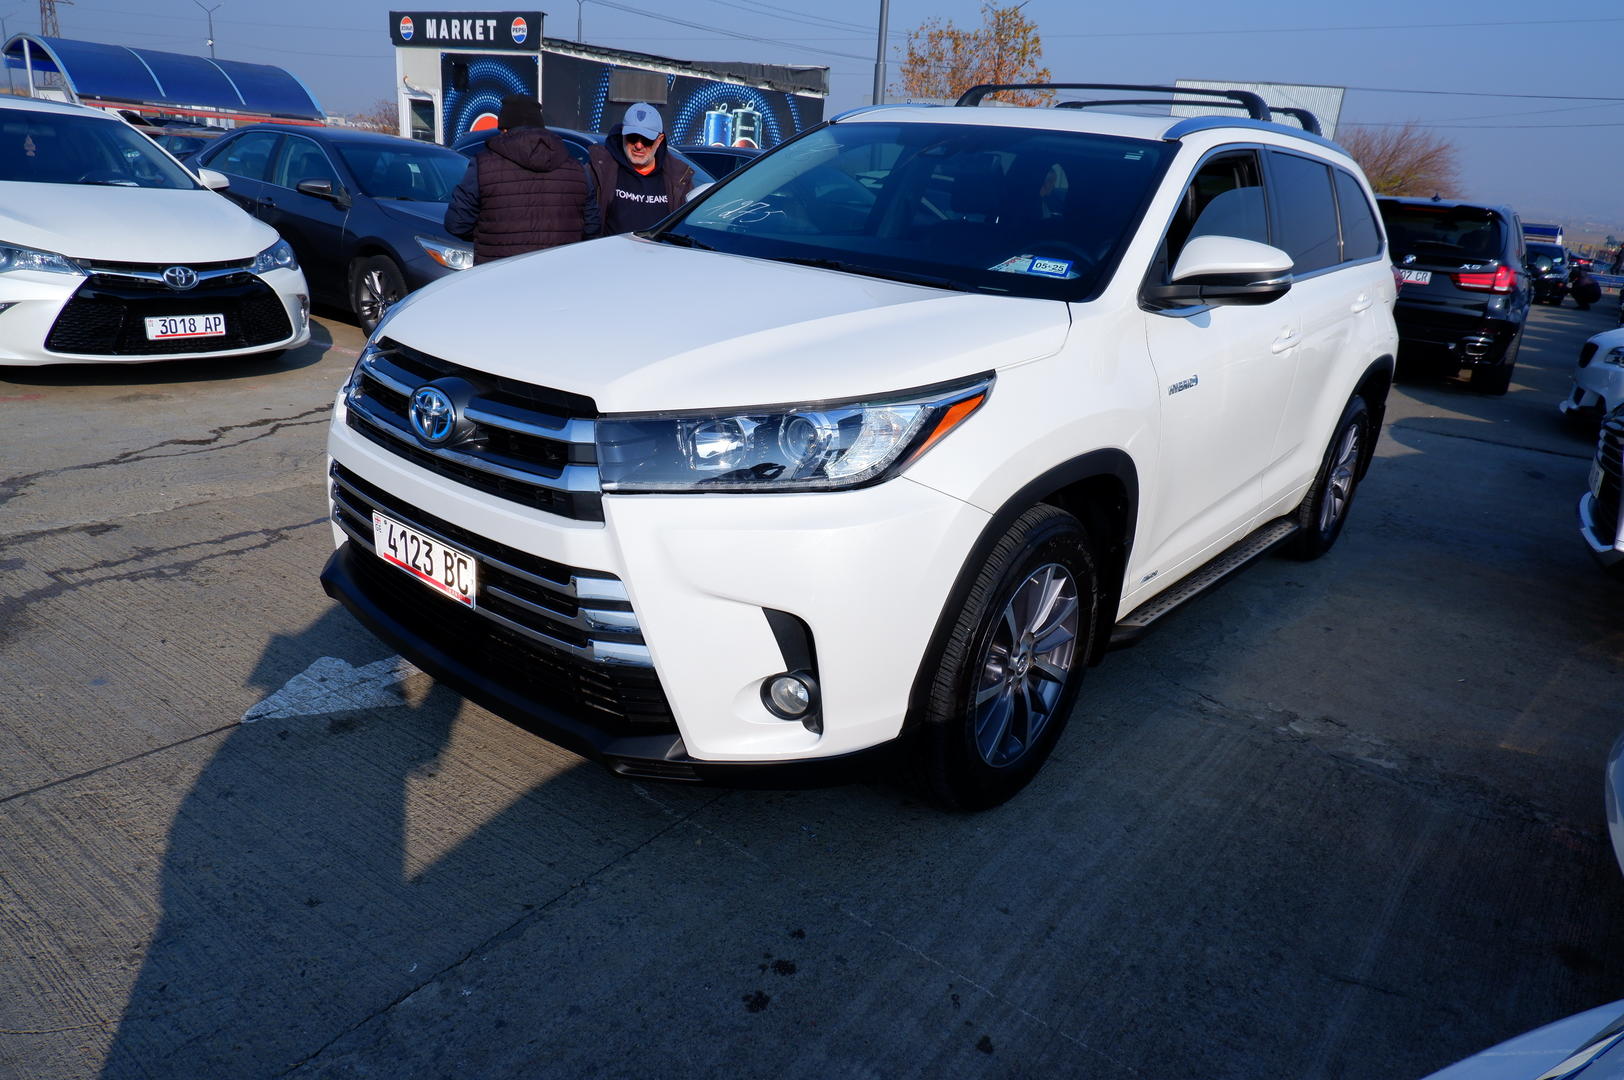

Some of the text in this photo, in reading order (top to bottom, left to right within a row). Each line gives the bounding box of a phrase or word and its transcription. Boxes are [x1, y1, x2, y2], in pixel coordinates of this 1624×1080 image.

[425, 18, 497, 41] MARKET
[512, 26, 528, 34] PEPSI
[615, 188, 669, 204] TOMMY JEANS
[158, 316, 222, 335] 3018 AP
[387, 523, 469, 596] 4123 BC
